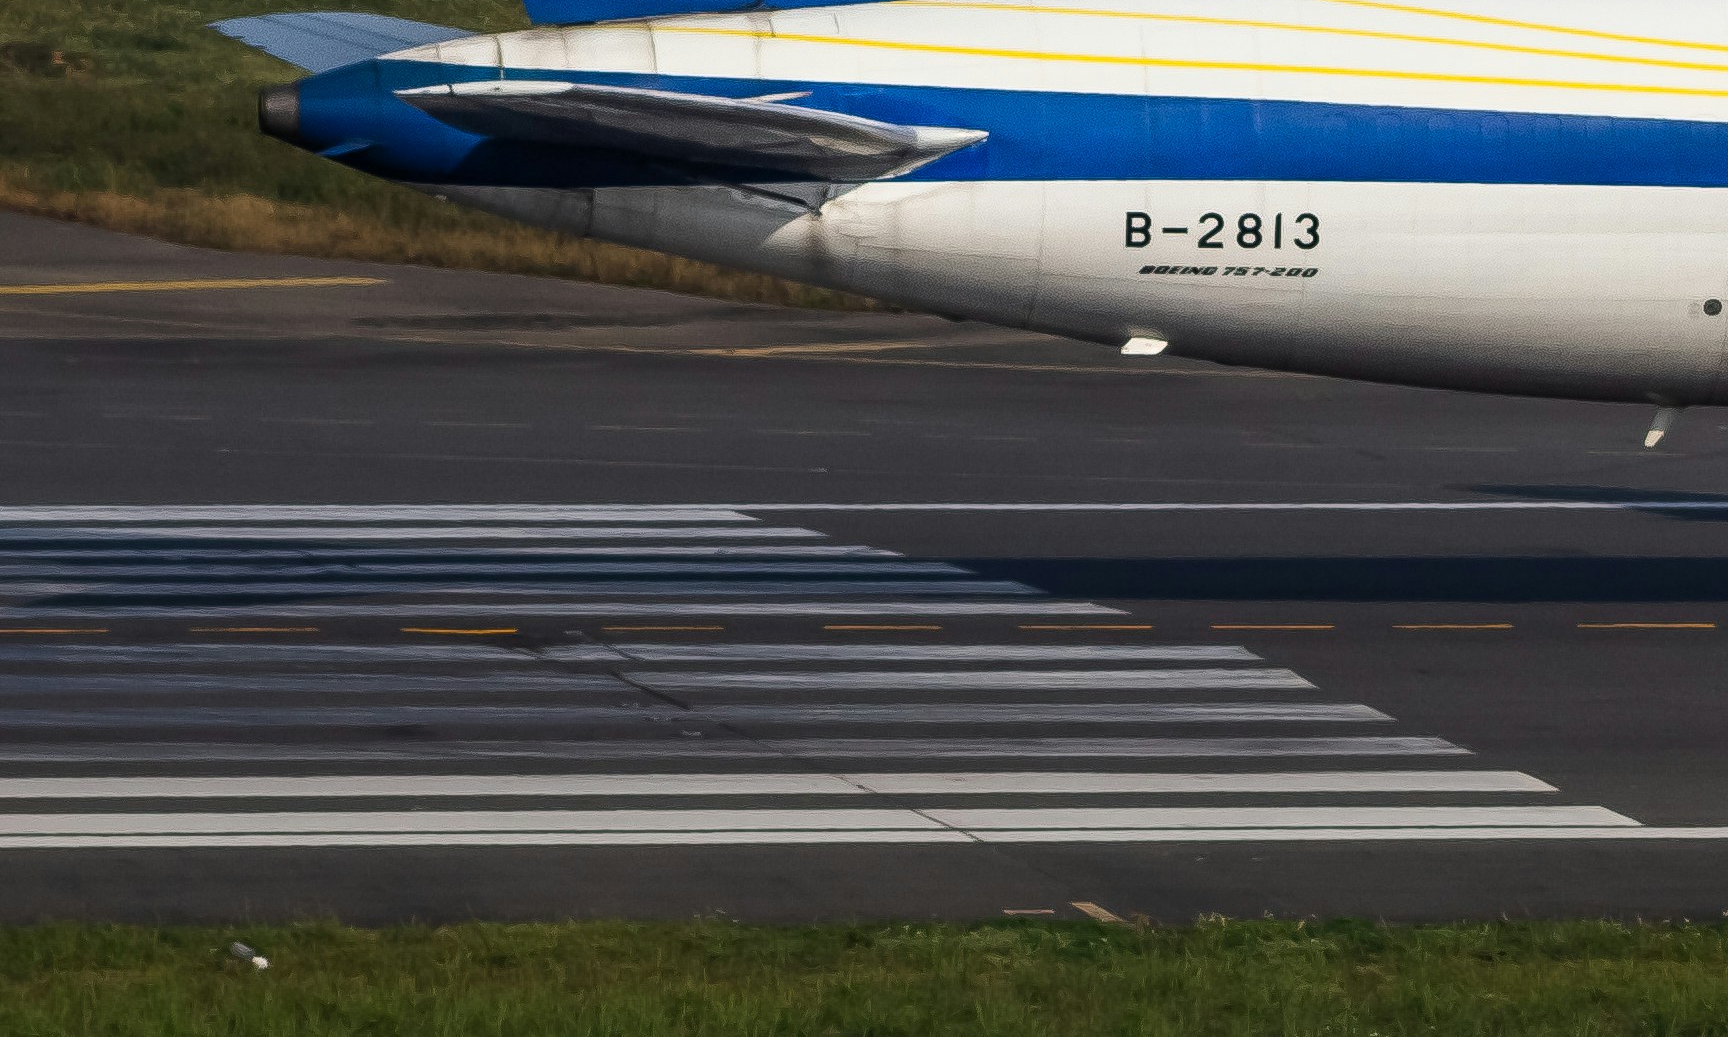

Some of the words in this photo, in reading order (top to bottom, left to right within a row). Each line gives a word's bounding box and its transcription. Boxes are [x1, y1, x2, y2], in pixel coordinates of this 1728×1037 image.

[1125, 211, 1320, 250] B-2813
[1138, 264, 1219, 276] BOEING
[1221, 266, 1319, 278] 757-200
